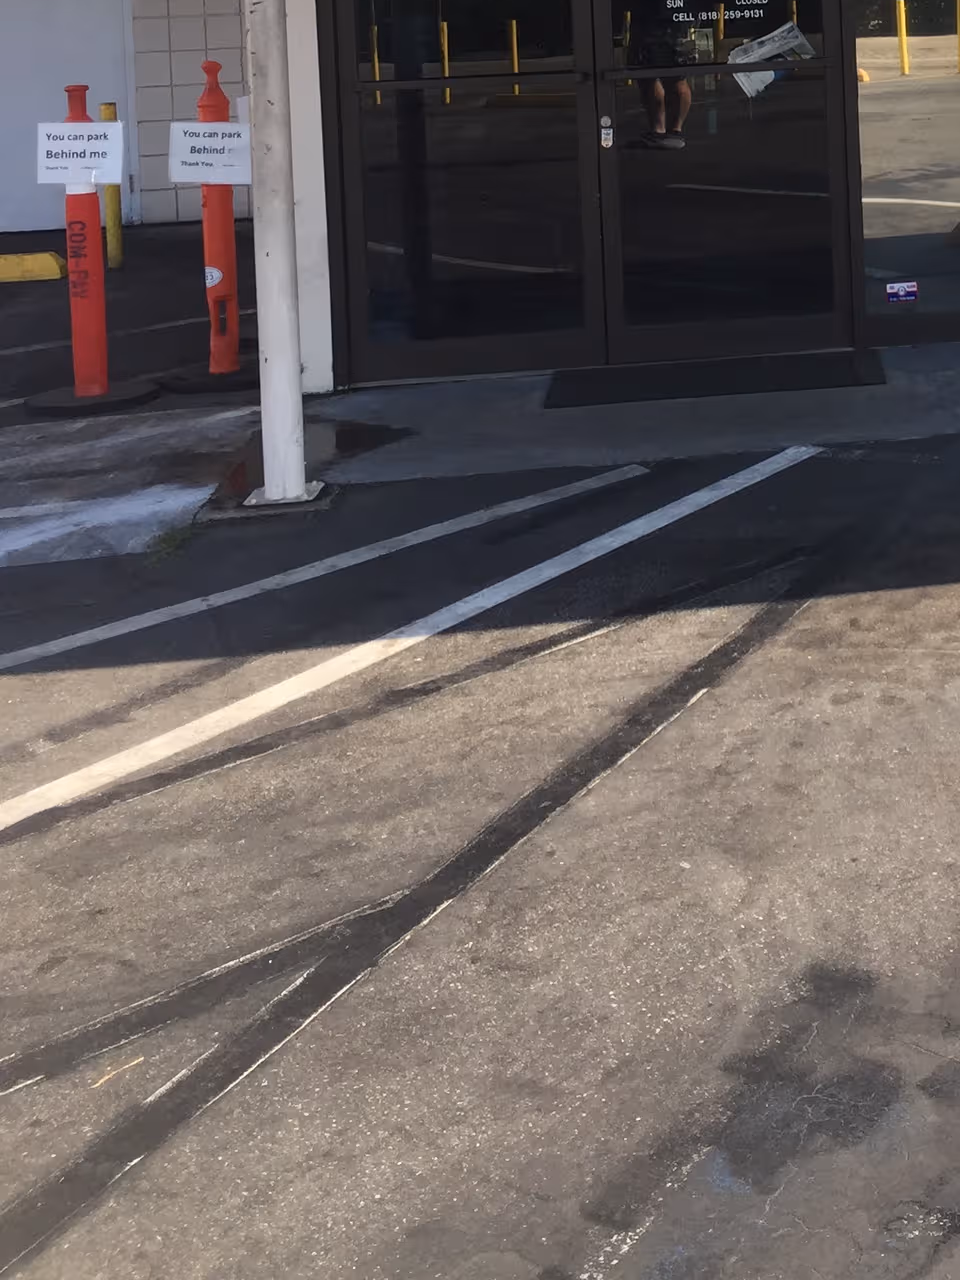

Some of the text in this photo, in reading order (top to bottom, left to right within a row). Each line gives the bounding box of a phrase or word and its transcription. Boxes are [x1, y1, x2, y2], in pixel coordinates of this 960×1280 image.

[666, 0, 684, 8] SUN
[673, 9, 764, 21] CELL (818) 259-9131
[46, 131, 109, 142] You can park
[183, 129, 201, 138] You
[221, 130, 242, 140] park
[45, 148, 108, 159] Behind me
[190, 145, 225, 154] Behind
